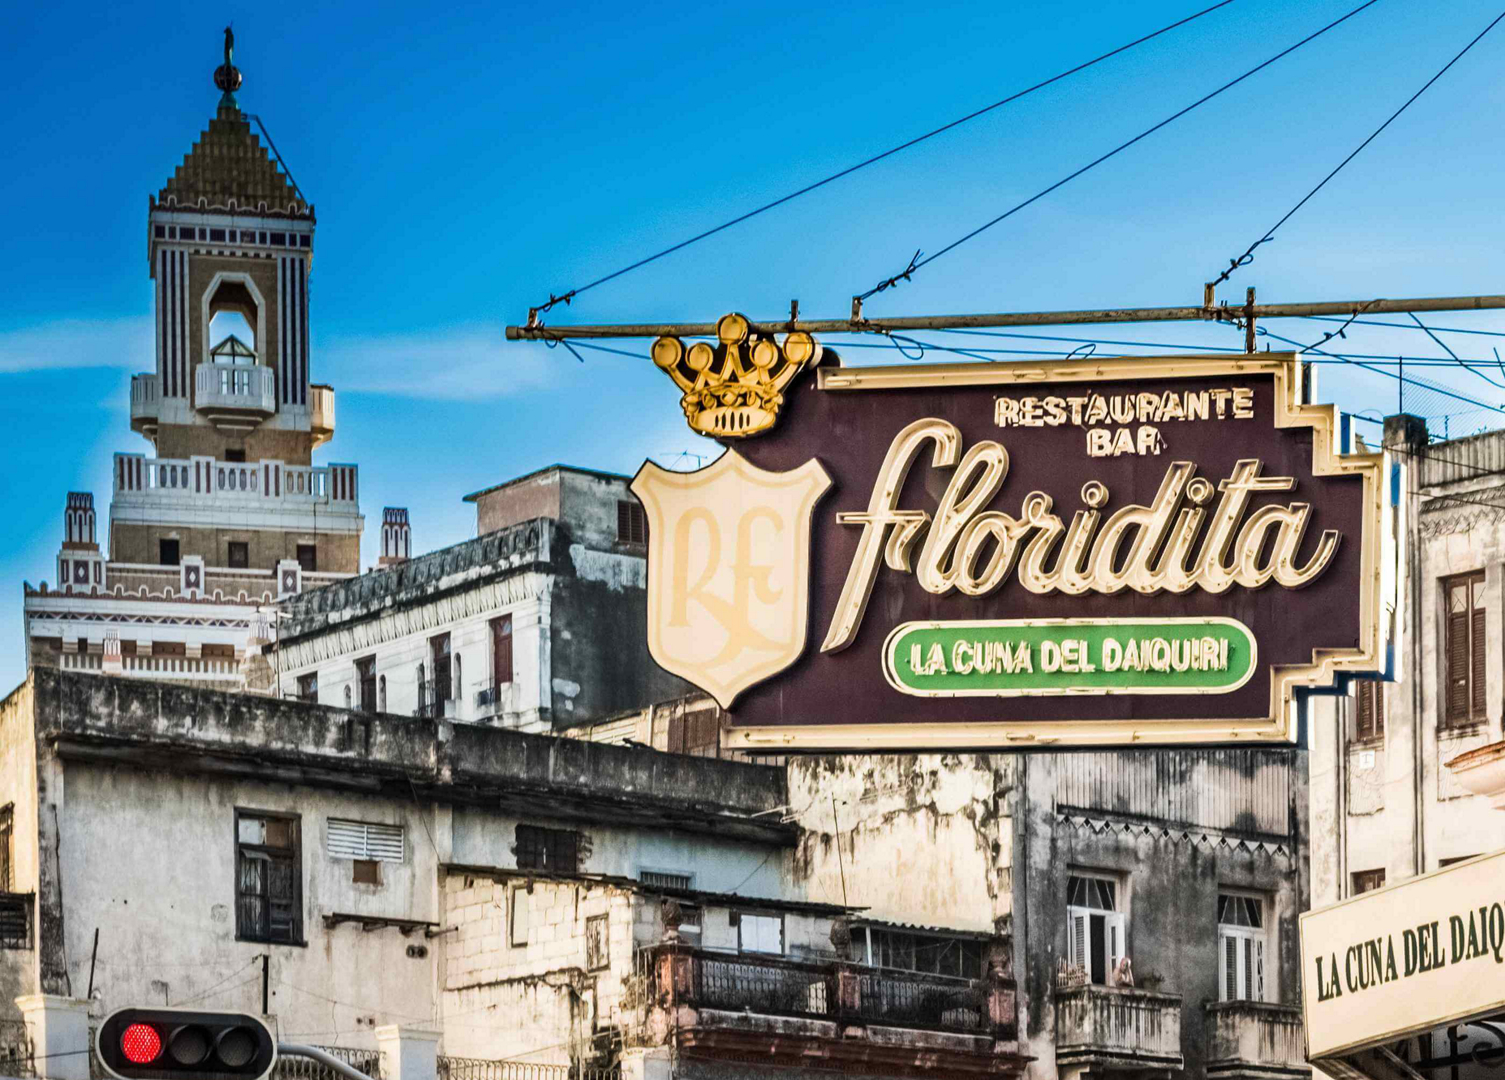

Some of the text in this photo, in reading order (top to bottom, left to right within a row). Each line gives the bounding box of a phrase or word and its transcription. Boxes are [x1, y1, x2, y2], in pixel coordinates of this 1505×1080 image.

[994, 388, 1254, 427] RESTAURANTE
[1087, 425, 1161, 457] BAR
[910, 637, 1229, 675] LA CUNA DEL DAIQUIRI
[1315, 955, 1343, 1002] LA
[1345, 936, 1398, 993] CUNA
[1403, 920, 1446, 978] DEL
